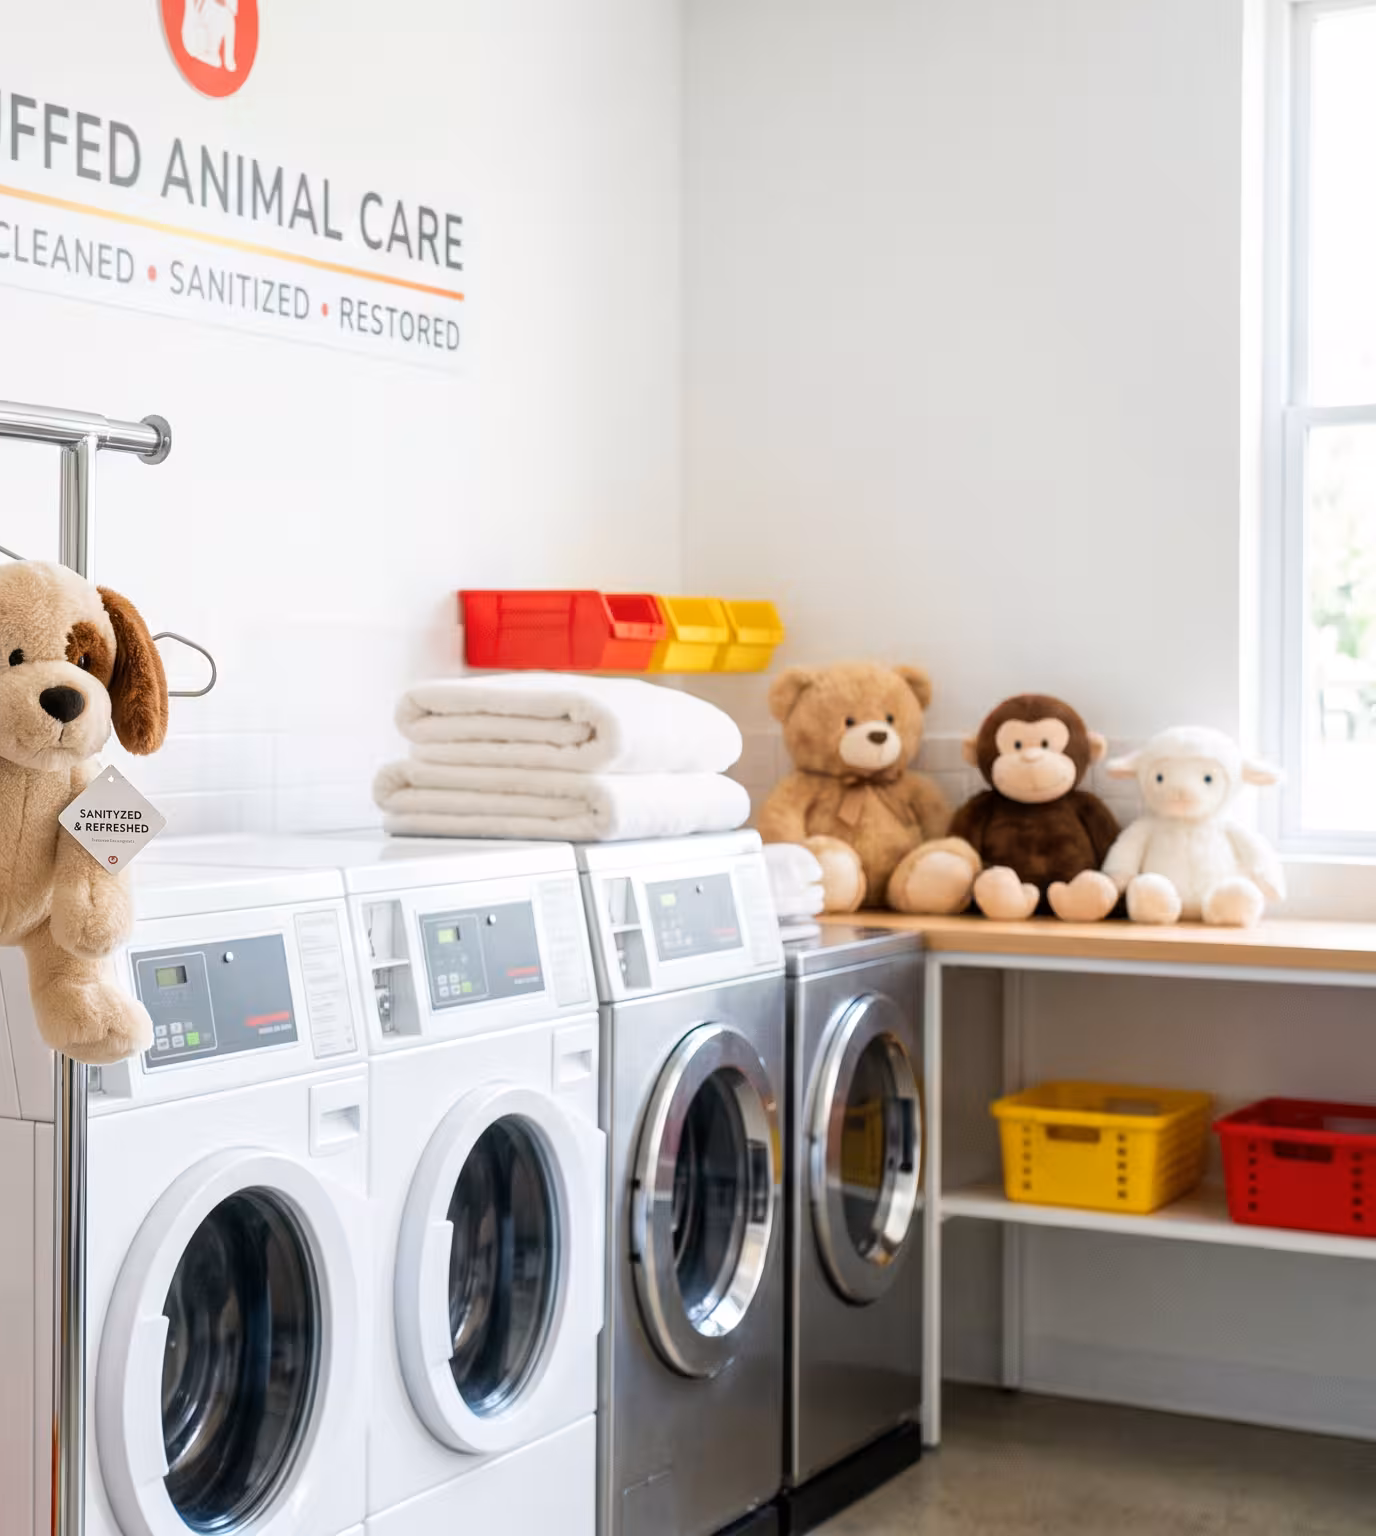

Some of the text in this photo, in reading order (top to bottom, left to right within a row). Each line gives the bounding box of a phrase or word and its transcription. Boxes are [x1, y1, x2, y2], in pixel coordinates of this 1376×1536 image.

[160, 137, 343, 241] ANIMAL
[359, 191, 464, 271] CARE
[170, 260, 310, 320] SANITIZED
[340, 296, 461, 351] RESTORED
[74, 822, 149, 833] & REFRESHED
[80, 809, 142, 820] SANITYZED
